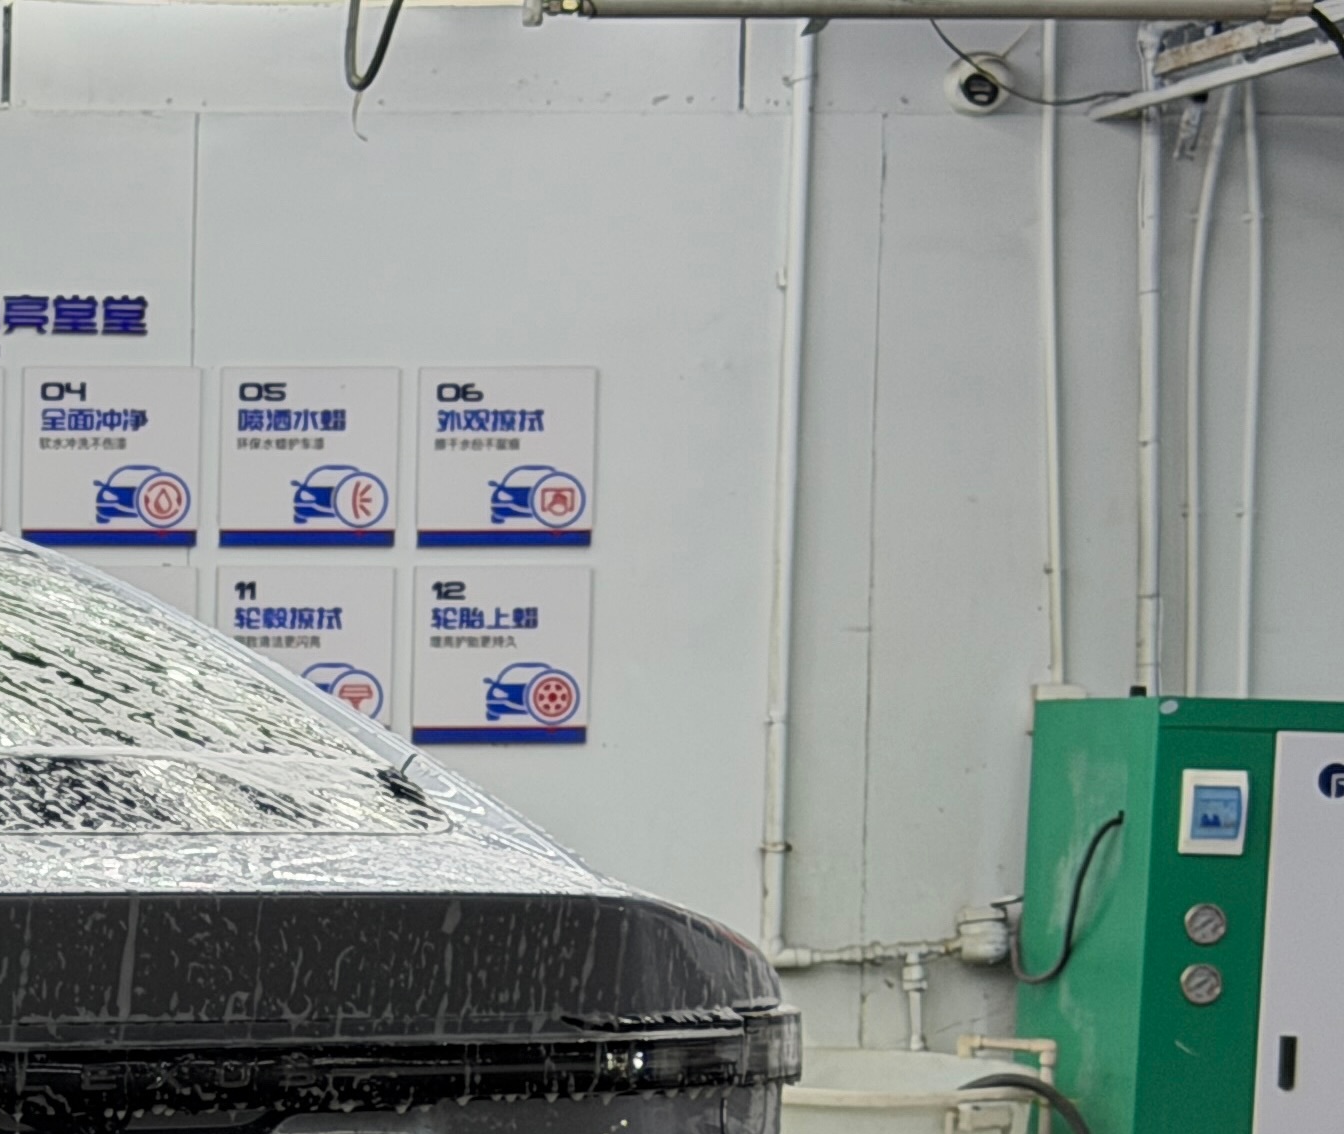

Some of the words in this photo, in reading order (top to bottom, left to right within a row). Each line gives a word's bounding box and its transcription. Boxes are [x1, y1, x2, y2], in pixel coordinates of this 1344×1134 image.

[40, 381, 87, 402] 04
[238, 382, 287, 402] 05
[436, 382, 484, 403] 06
[41, 408, 149, 432] 全面冲净
[237, 408, 347, 432] 喷洒水蜡
[437, 408, 545, 433] 外观擦拭
[234, 581, 257, 601] 11
[431, 581, 466, 601] 12
[234, 606, 343, 630] 轮毂擦拭
[431, 606, 539, 631] 轮胎上蜡
